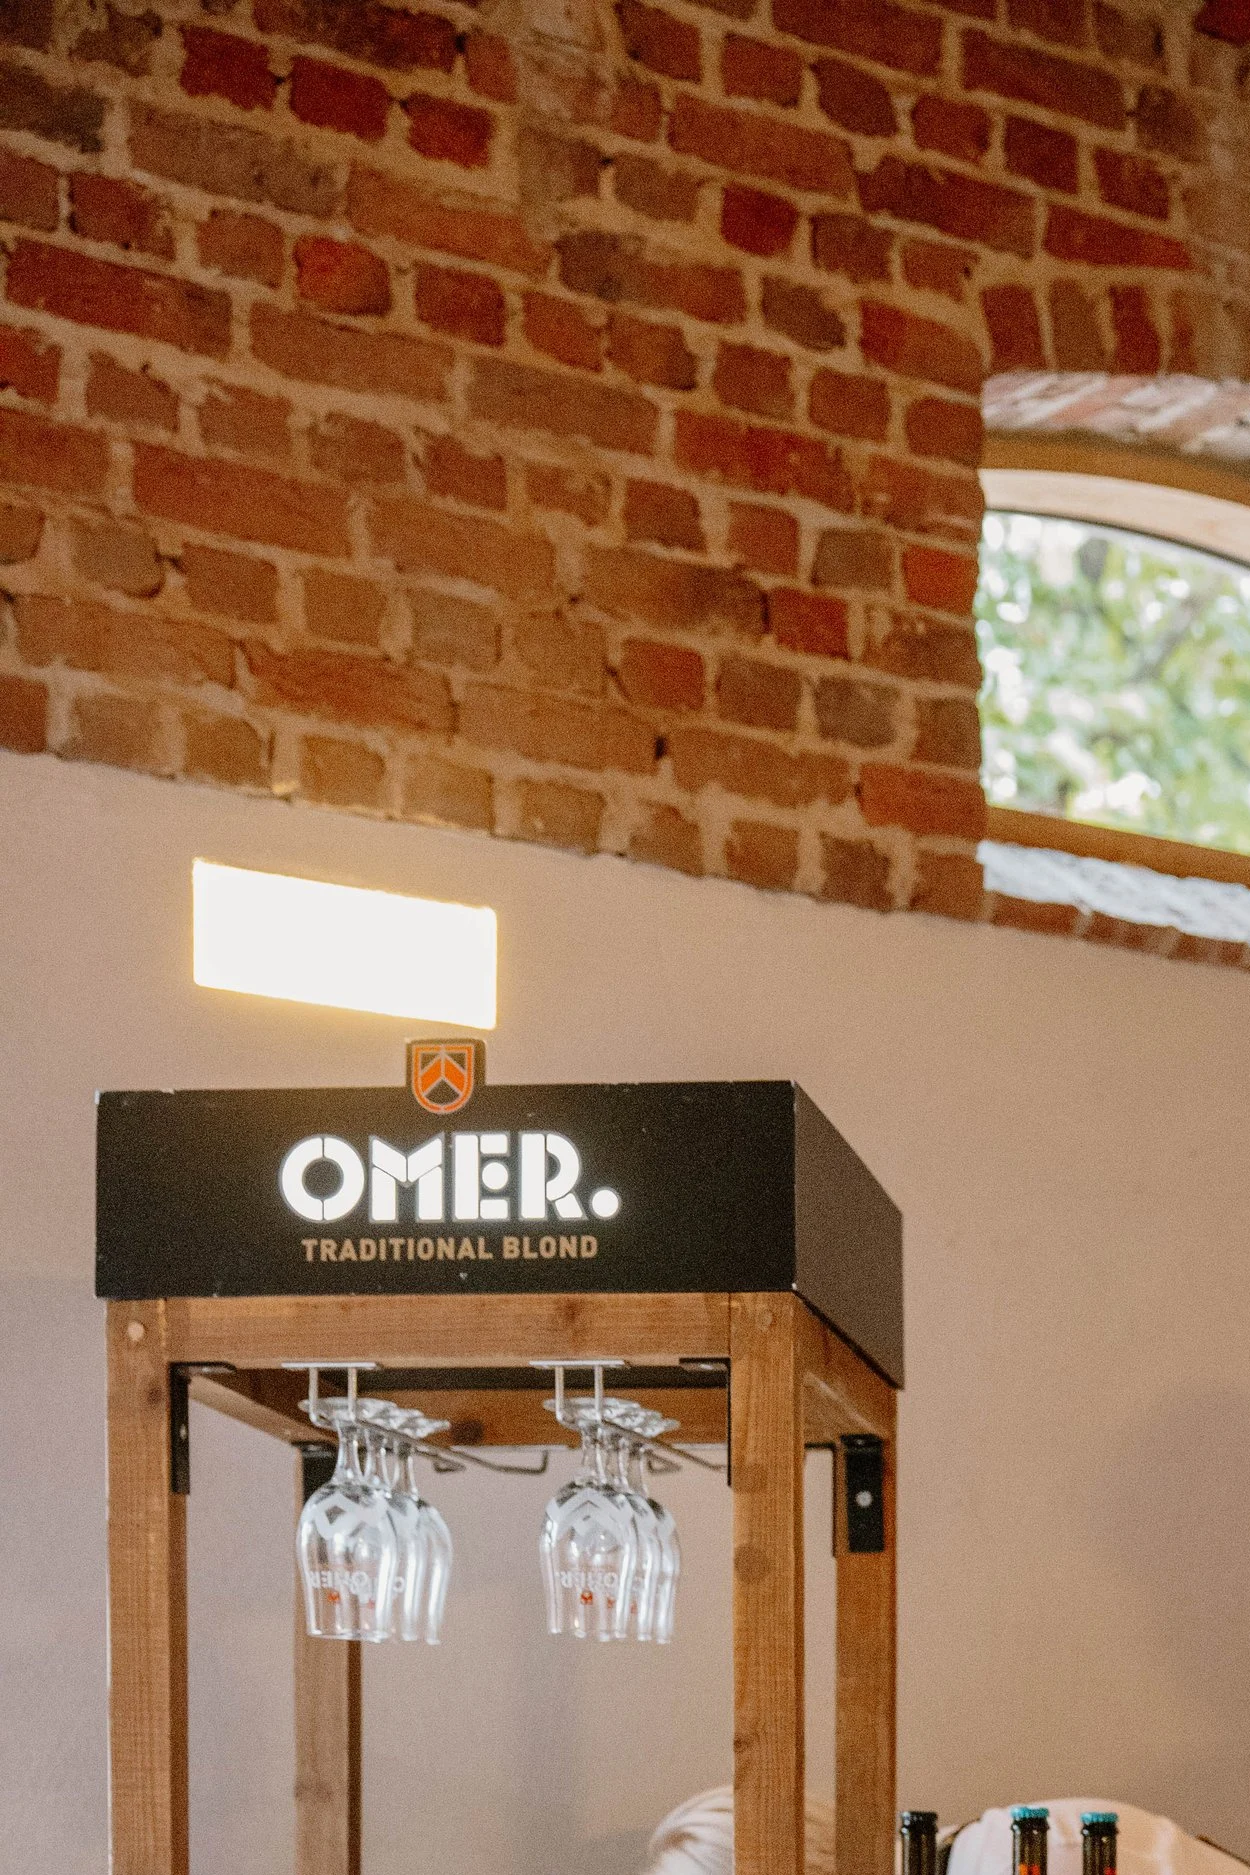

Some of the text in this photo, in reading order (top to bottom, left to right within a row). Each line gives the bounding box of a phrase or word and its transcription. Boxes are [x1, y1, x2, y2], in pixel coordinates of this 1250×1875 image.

[280, 1133, 620, 1223] OMER.
[301, 1236, 598, 1262] TRADITIONAL BLOND
